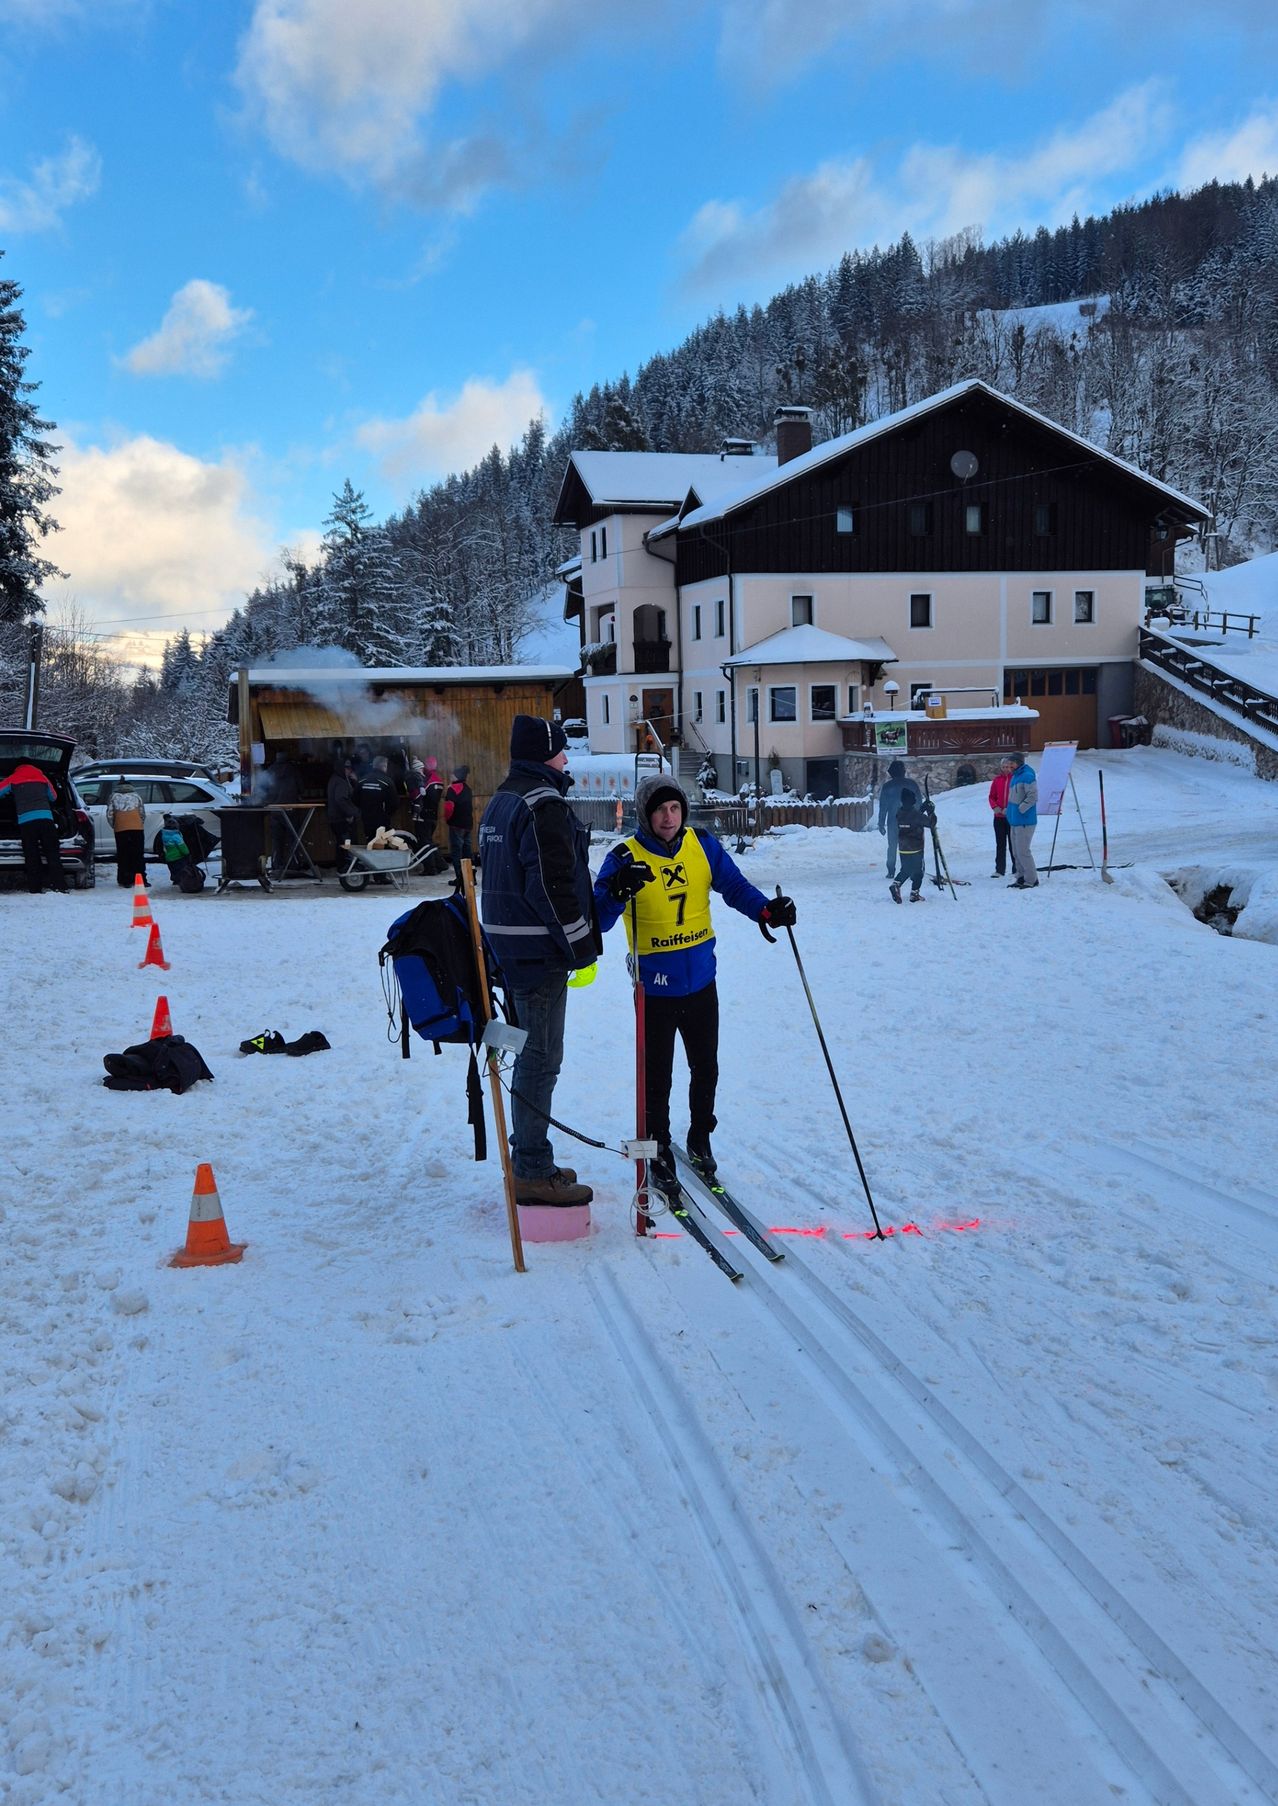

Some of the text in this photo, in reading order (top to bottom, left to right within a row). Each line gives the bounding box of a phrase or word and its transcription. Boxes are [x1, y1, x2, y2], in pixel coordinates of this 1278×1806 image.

[668, 892, 687, 927] 7
[651, 928, 708, 948] Raiffeisen
[653, 972, 669, 986] AK
